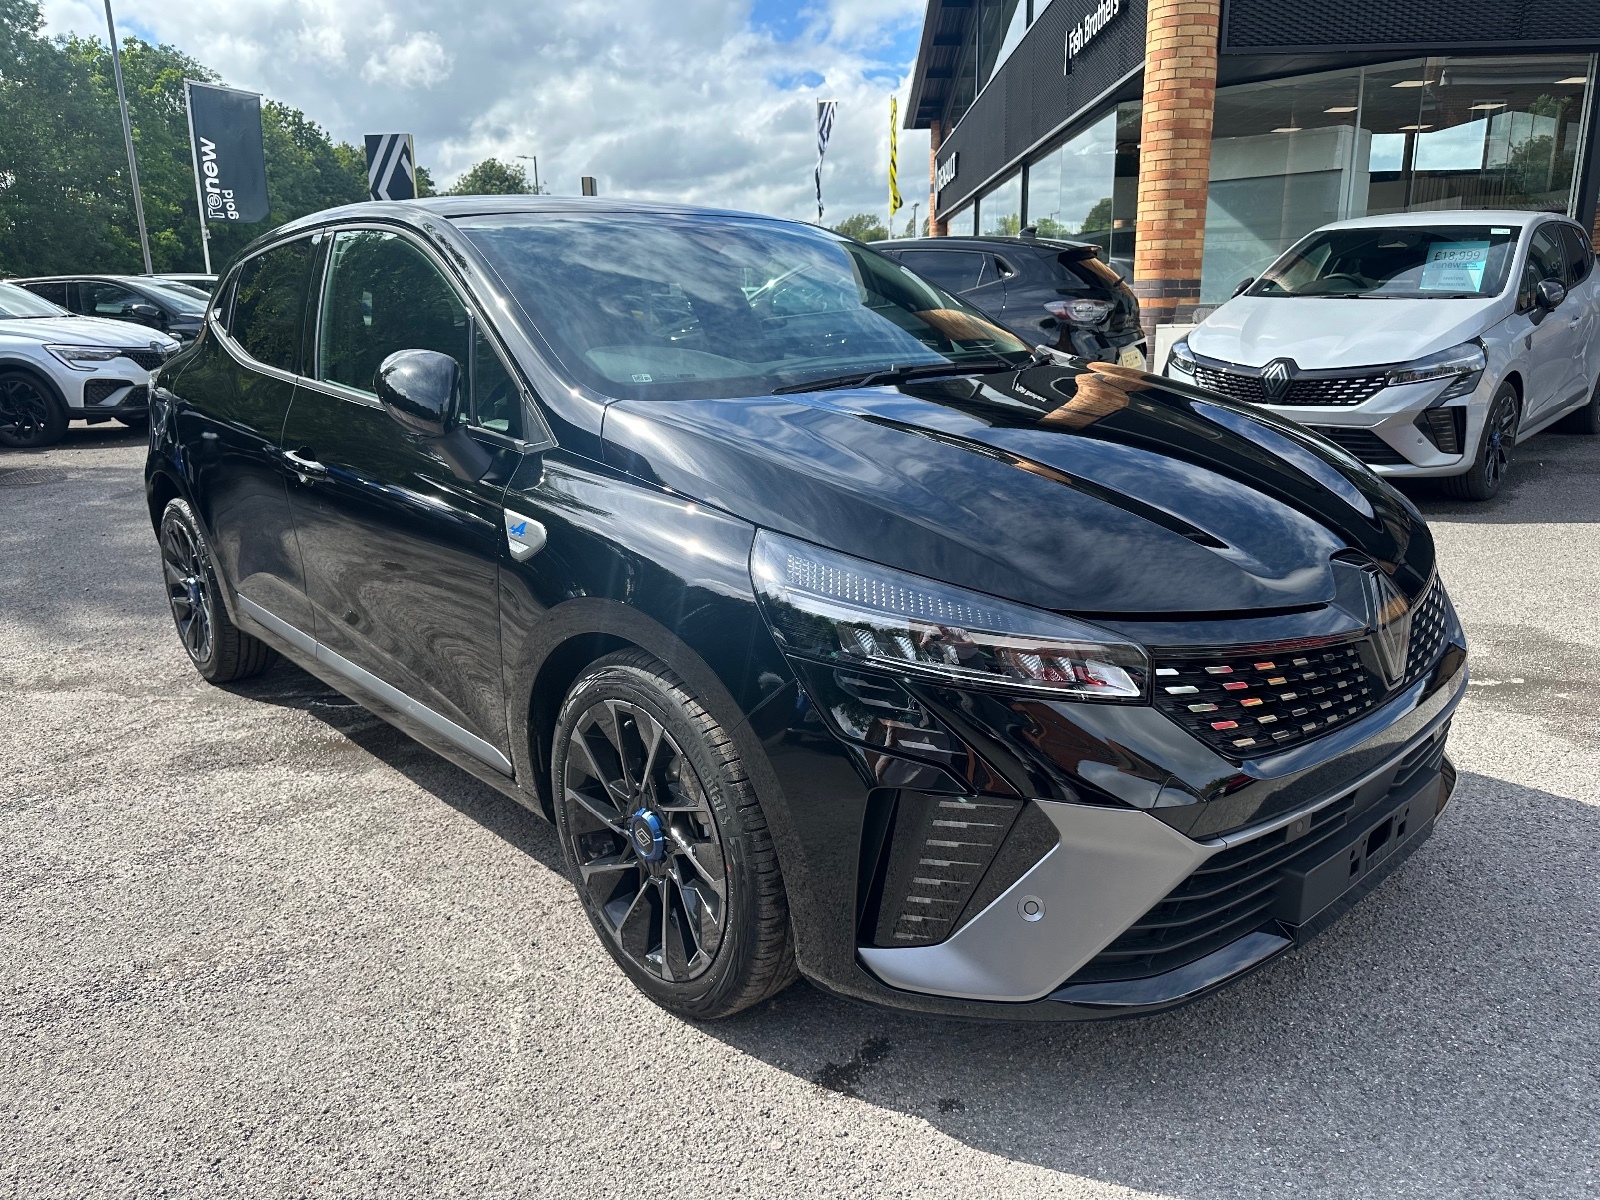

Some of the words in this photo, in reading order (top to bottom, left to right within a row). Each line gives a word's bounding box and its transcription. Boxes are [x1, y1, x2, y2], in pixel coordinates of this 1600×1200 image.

[1069, 23, 1083, 59] Fish
[1084, 0, 1119, 44] Brothers
[200, 137, 225, 218] renew
[222, 189, 239, 219] gold
[1434, 250, 1480, 262] £18,999
